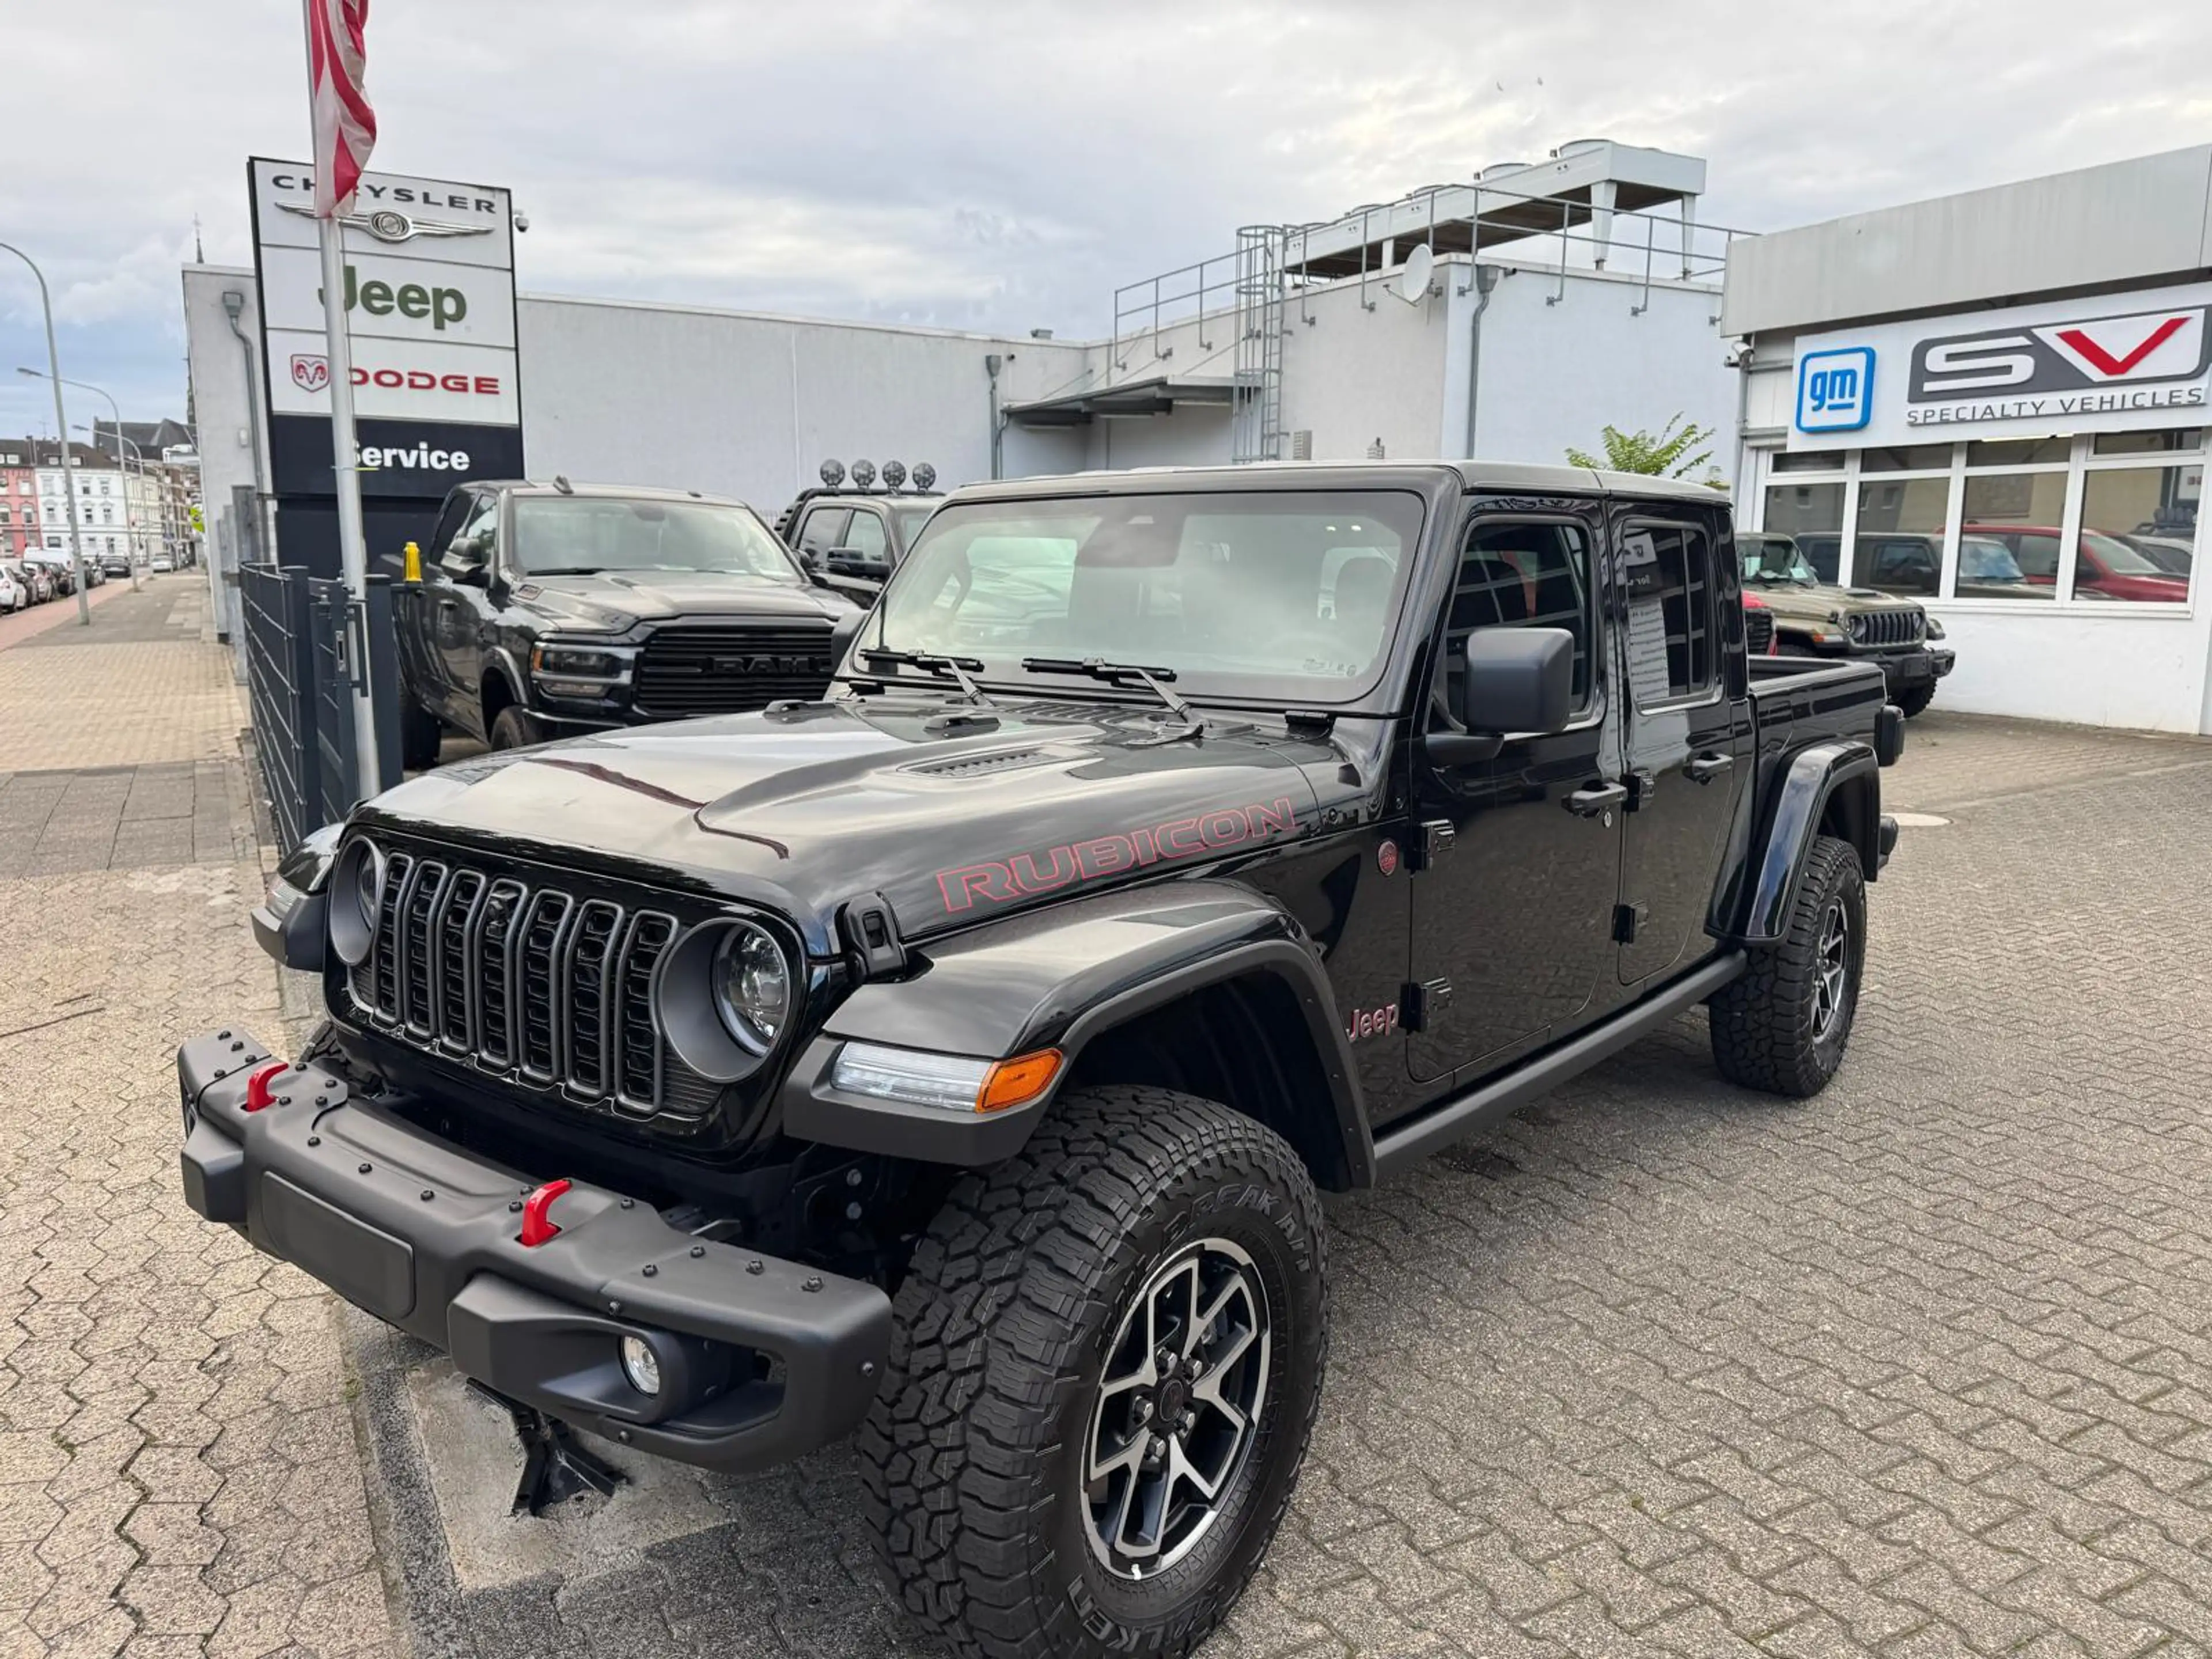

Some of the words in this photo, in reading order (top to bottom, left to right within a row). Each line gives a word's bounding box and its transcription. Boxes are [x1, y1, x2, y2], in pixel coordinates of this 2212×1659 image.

[318, 265, 467, 330] Jeep
[1809, 368, 1857, 412] gm
[1907, 400, 2046, 424] SPECIALTY
[2059, 388, 2204, 414] VEHICLES
[713, 655, 809, 674] RAM
[936, 797, 1297, 912] RUBICON
[1346, 1003, 1399, 1043] Jeep
